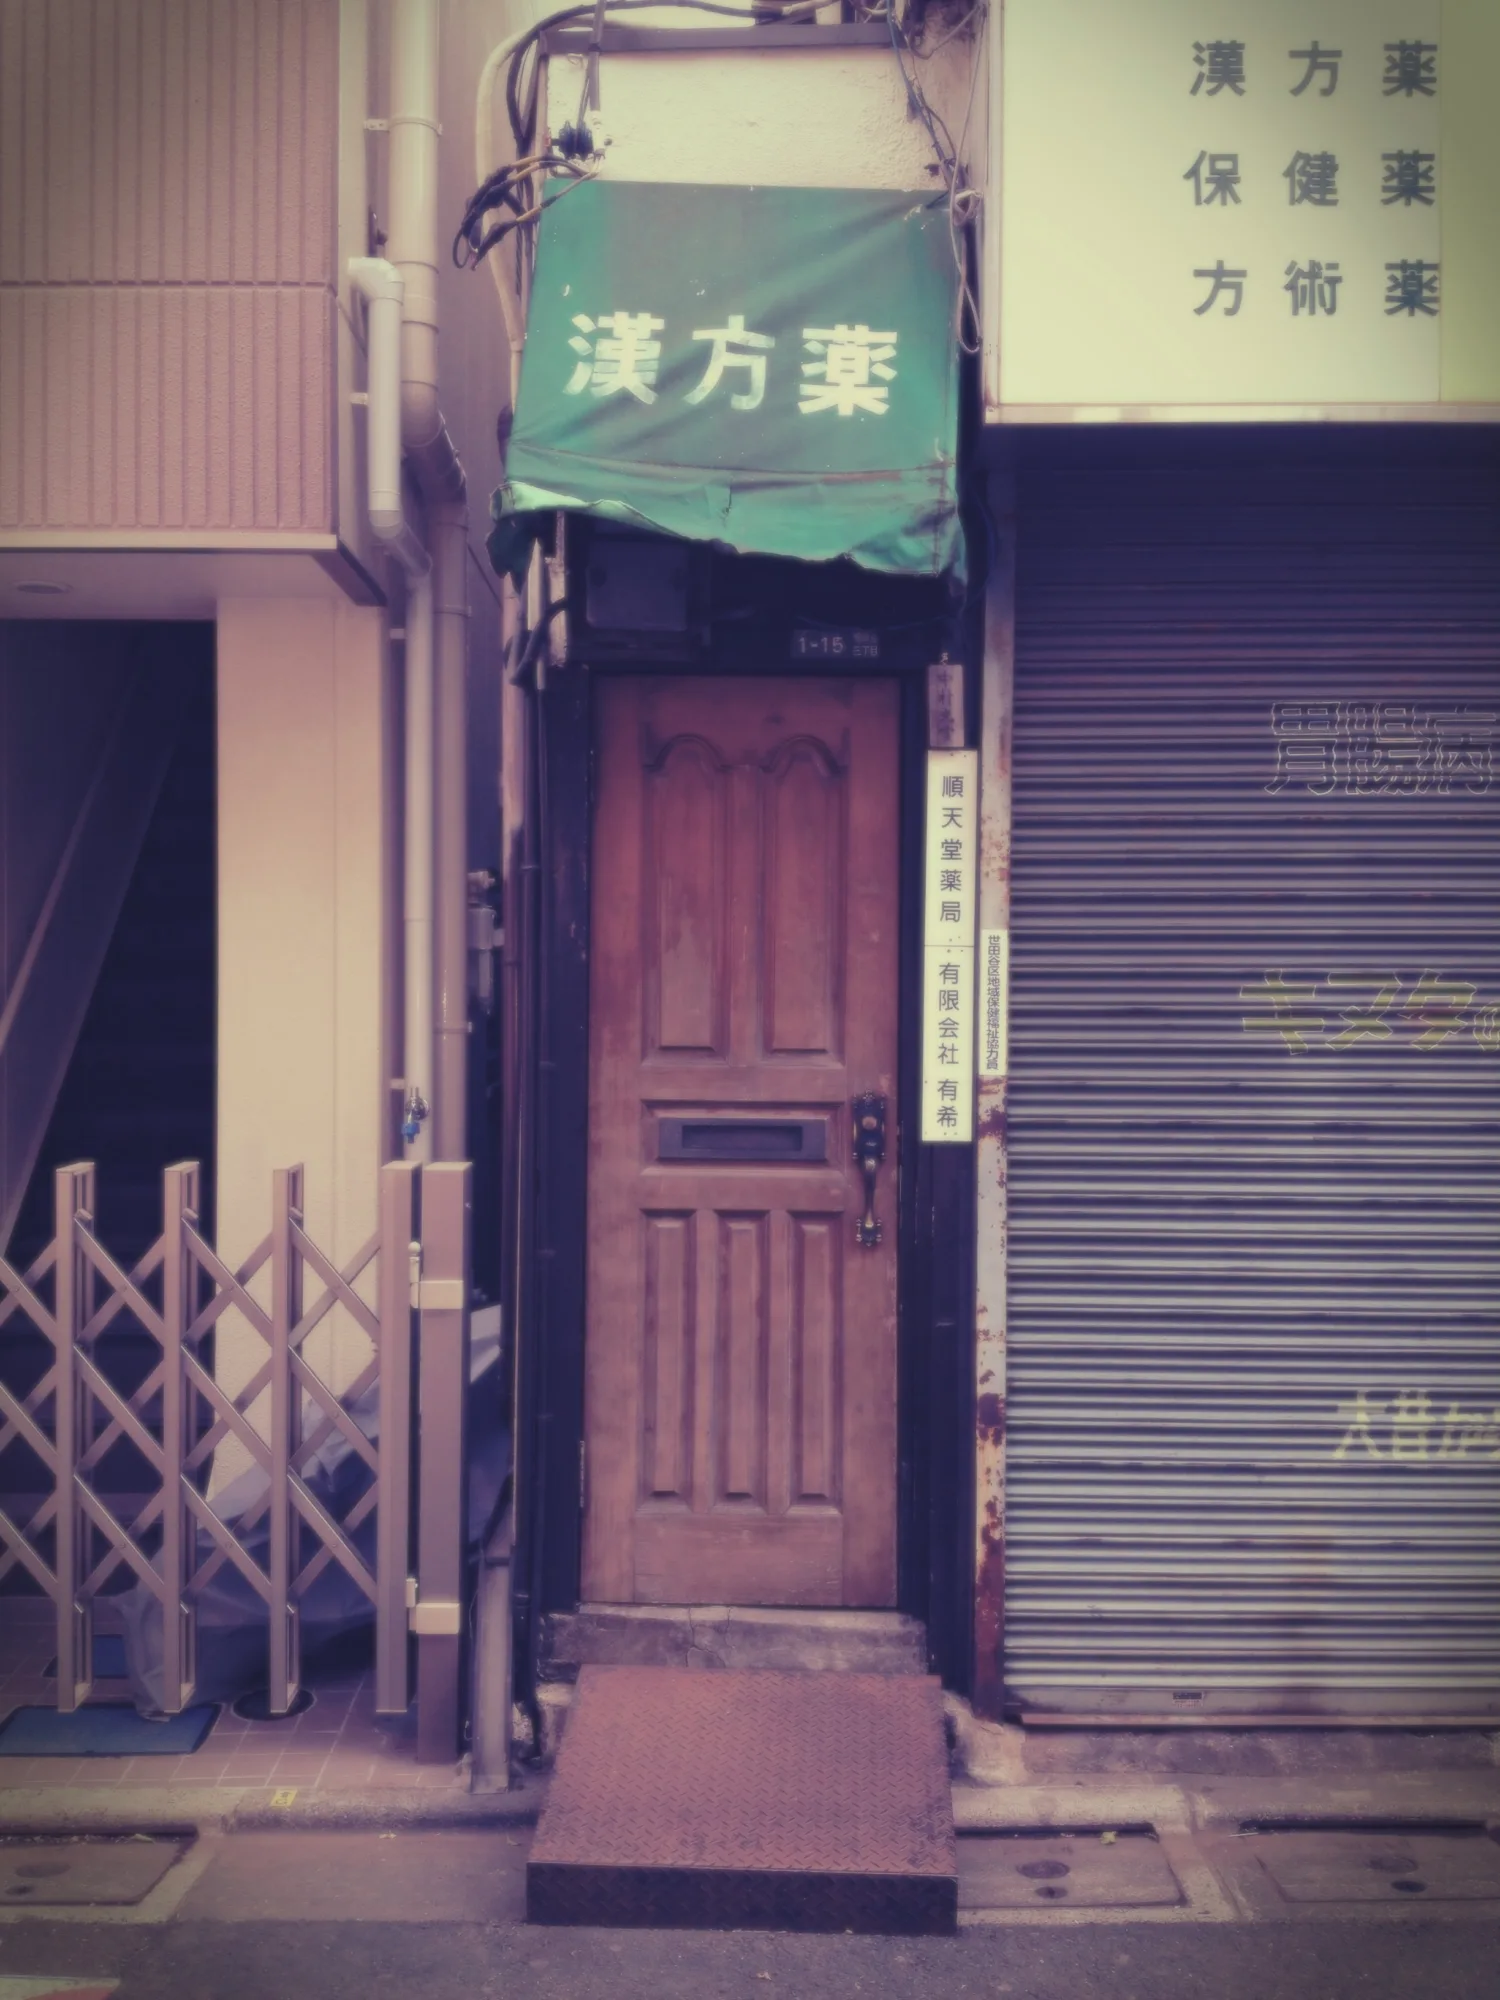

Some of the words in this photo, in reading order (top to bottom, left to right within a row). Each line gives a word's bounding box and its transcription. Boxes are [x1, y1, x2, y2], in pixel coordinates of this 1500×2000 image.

[1189, 40, 1438, 97] 漢方薬
[1182, 149, 1436, 206] 保健薬
[1192, 259, 1440, 317] 方術薬
[562, 310, 898, 416] 漢方薬
[798, 636, 844, 654] 1-15
[939, 775, 965, 923] 順天堂薬局
[937, 962, 961, 1065] 有限会社
[936, 1078, 959, 1128] 有希
